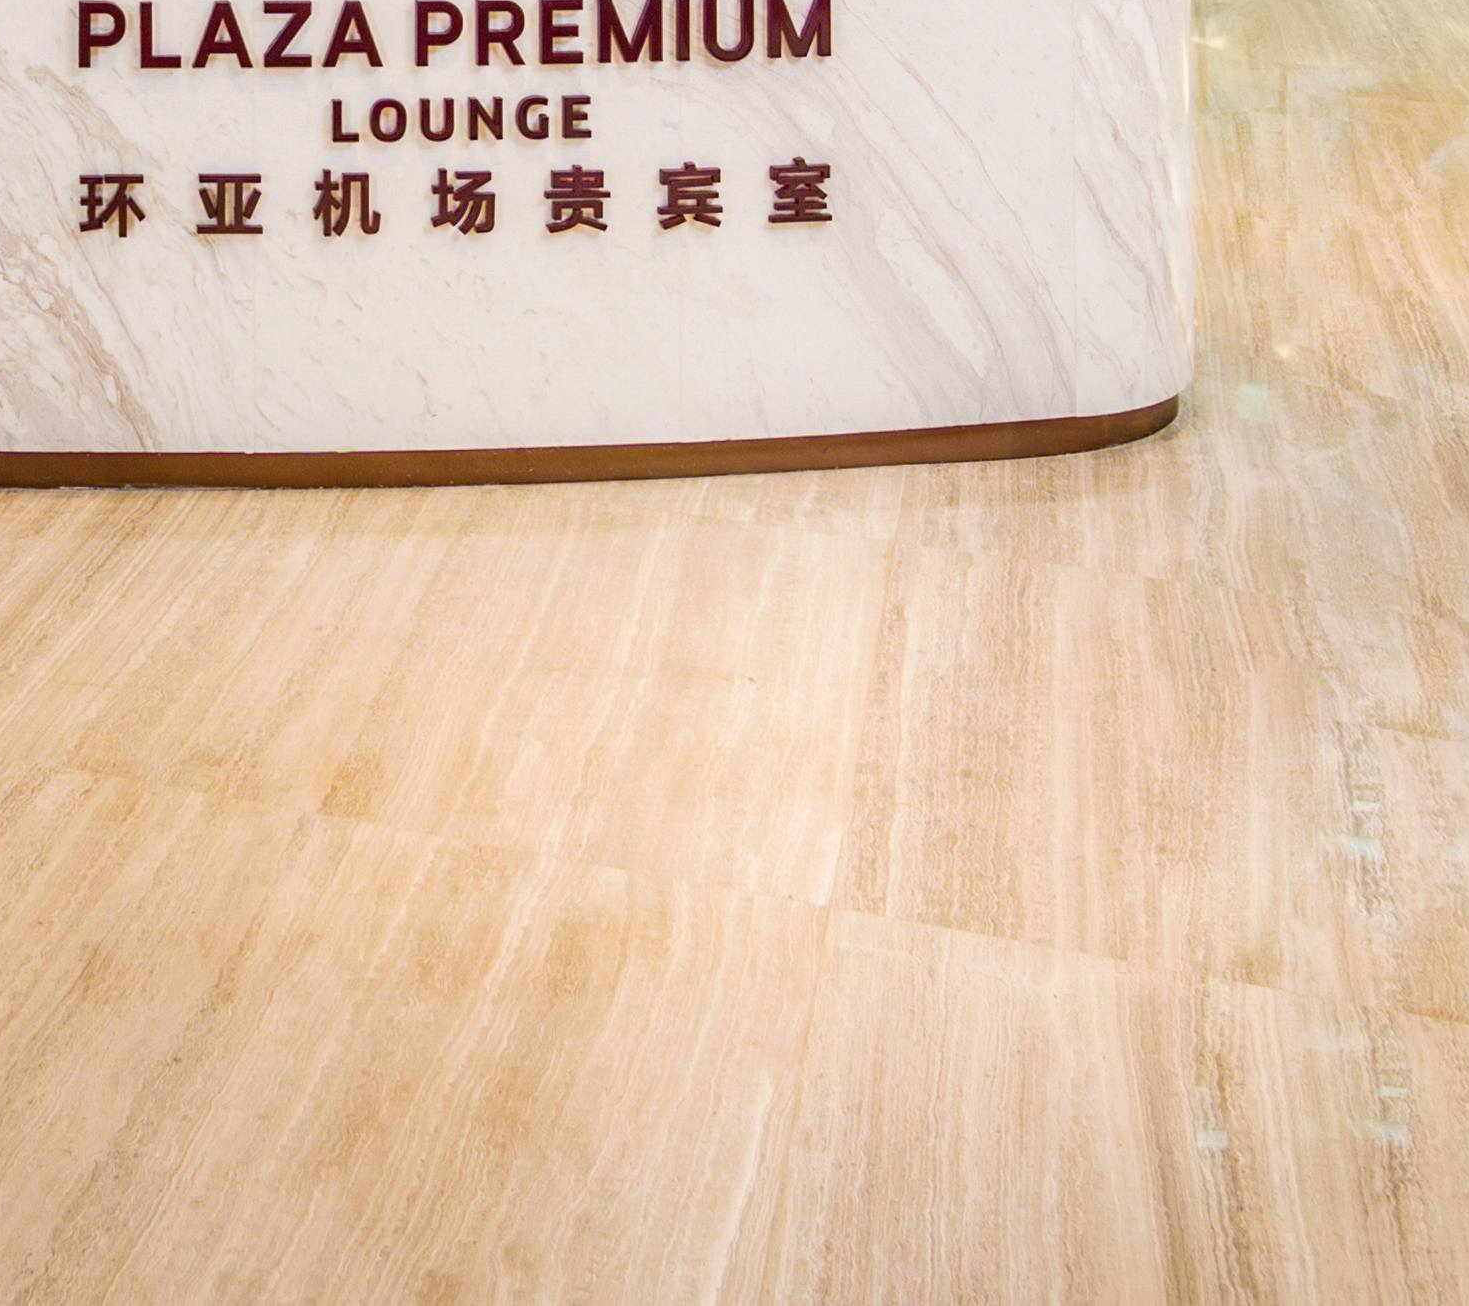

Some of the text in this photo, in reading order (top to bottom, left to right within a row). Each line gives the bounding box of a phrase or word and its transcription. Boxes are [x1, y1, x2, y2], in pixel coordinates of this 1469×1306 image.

[77, 0, 384, 70] PLAZA
[331, 94, 592, 144] LOUNGE
[78, 156, 834, 239] 环亚机场贵宾室
